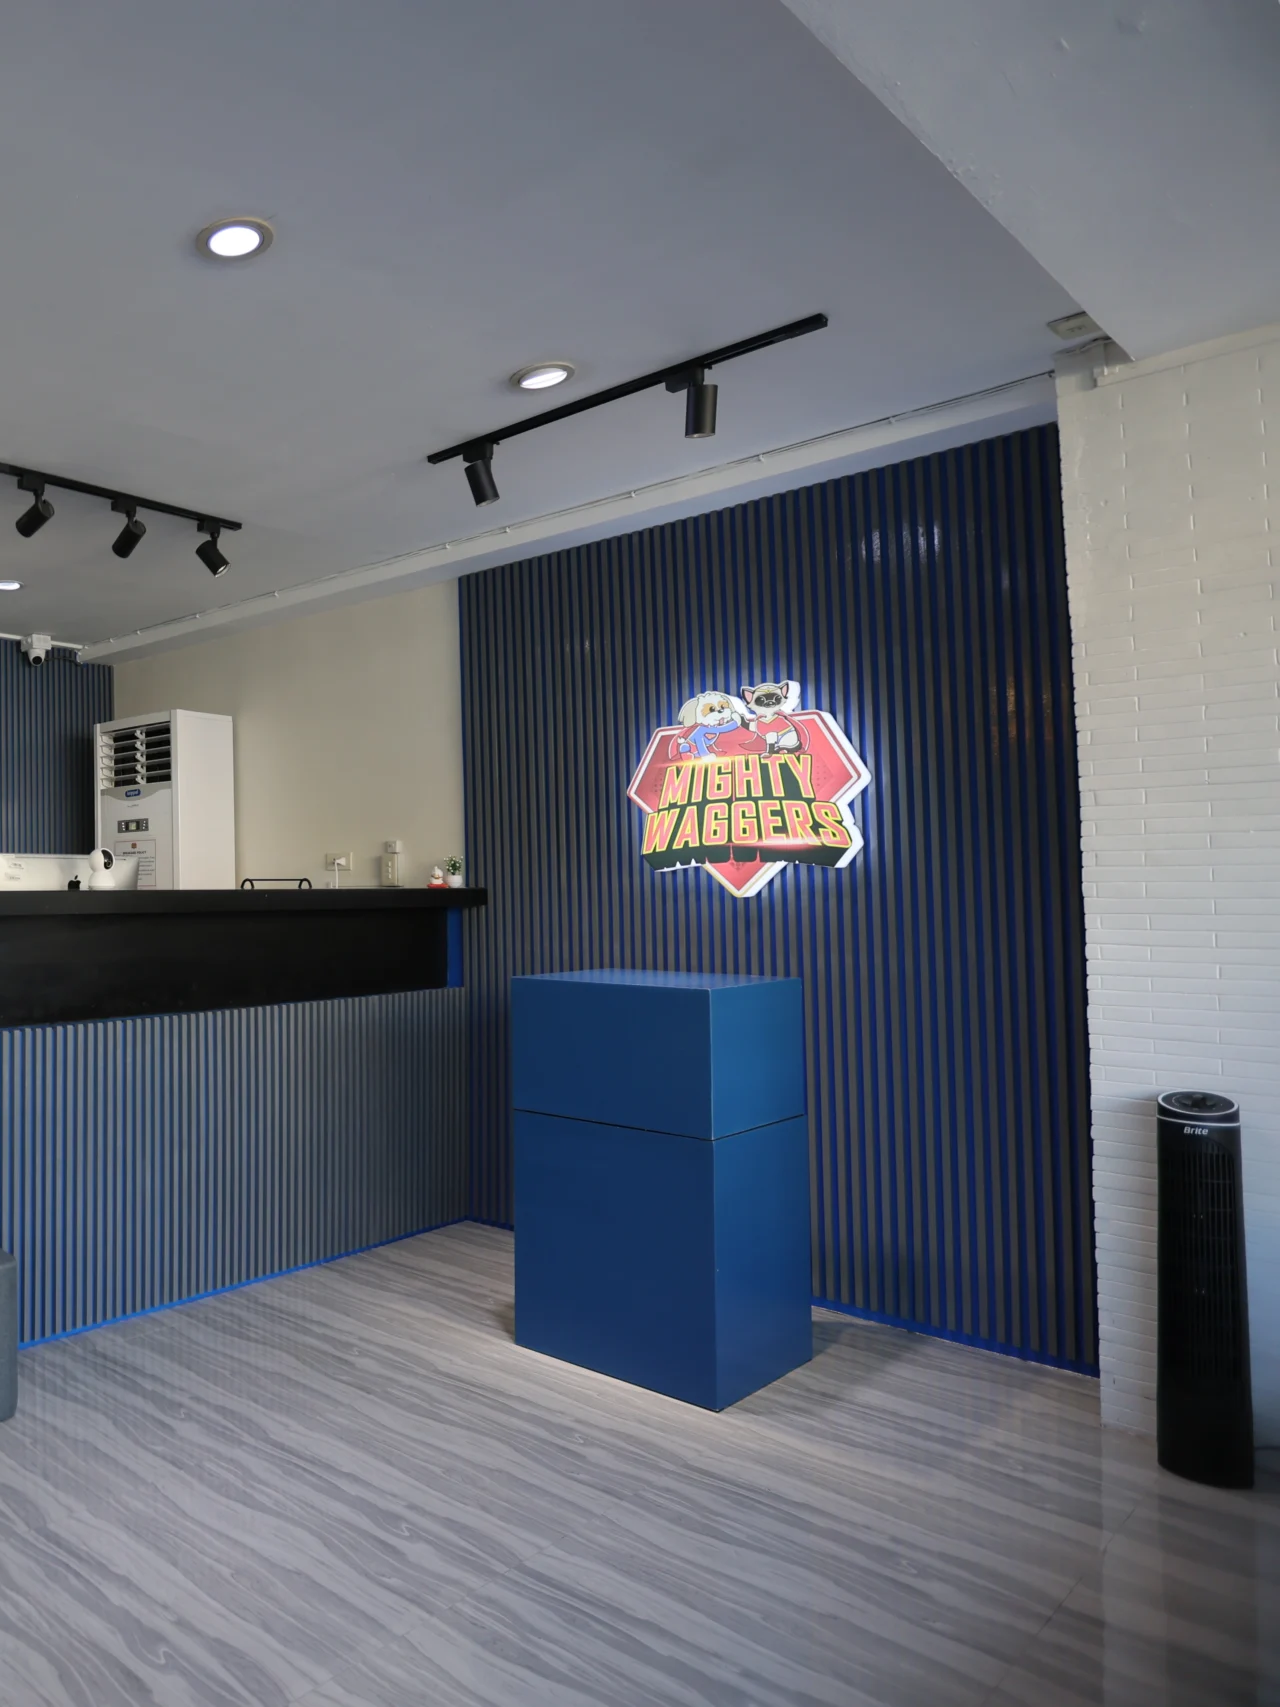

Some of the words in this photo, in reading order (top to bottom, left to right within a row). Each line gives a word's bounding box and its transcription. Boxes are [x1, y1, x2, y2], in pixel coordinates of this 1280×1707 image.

[658, 753, 815, 809] MIGHTY
[642, 800, 853, 854] WAGGERS
[1183, 1126, 1209, 1135] Brite
